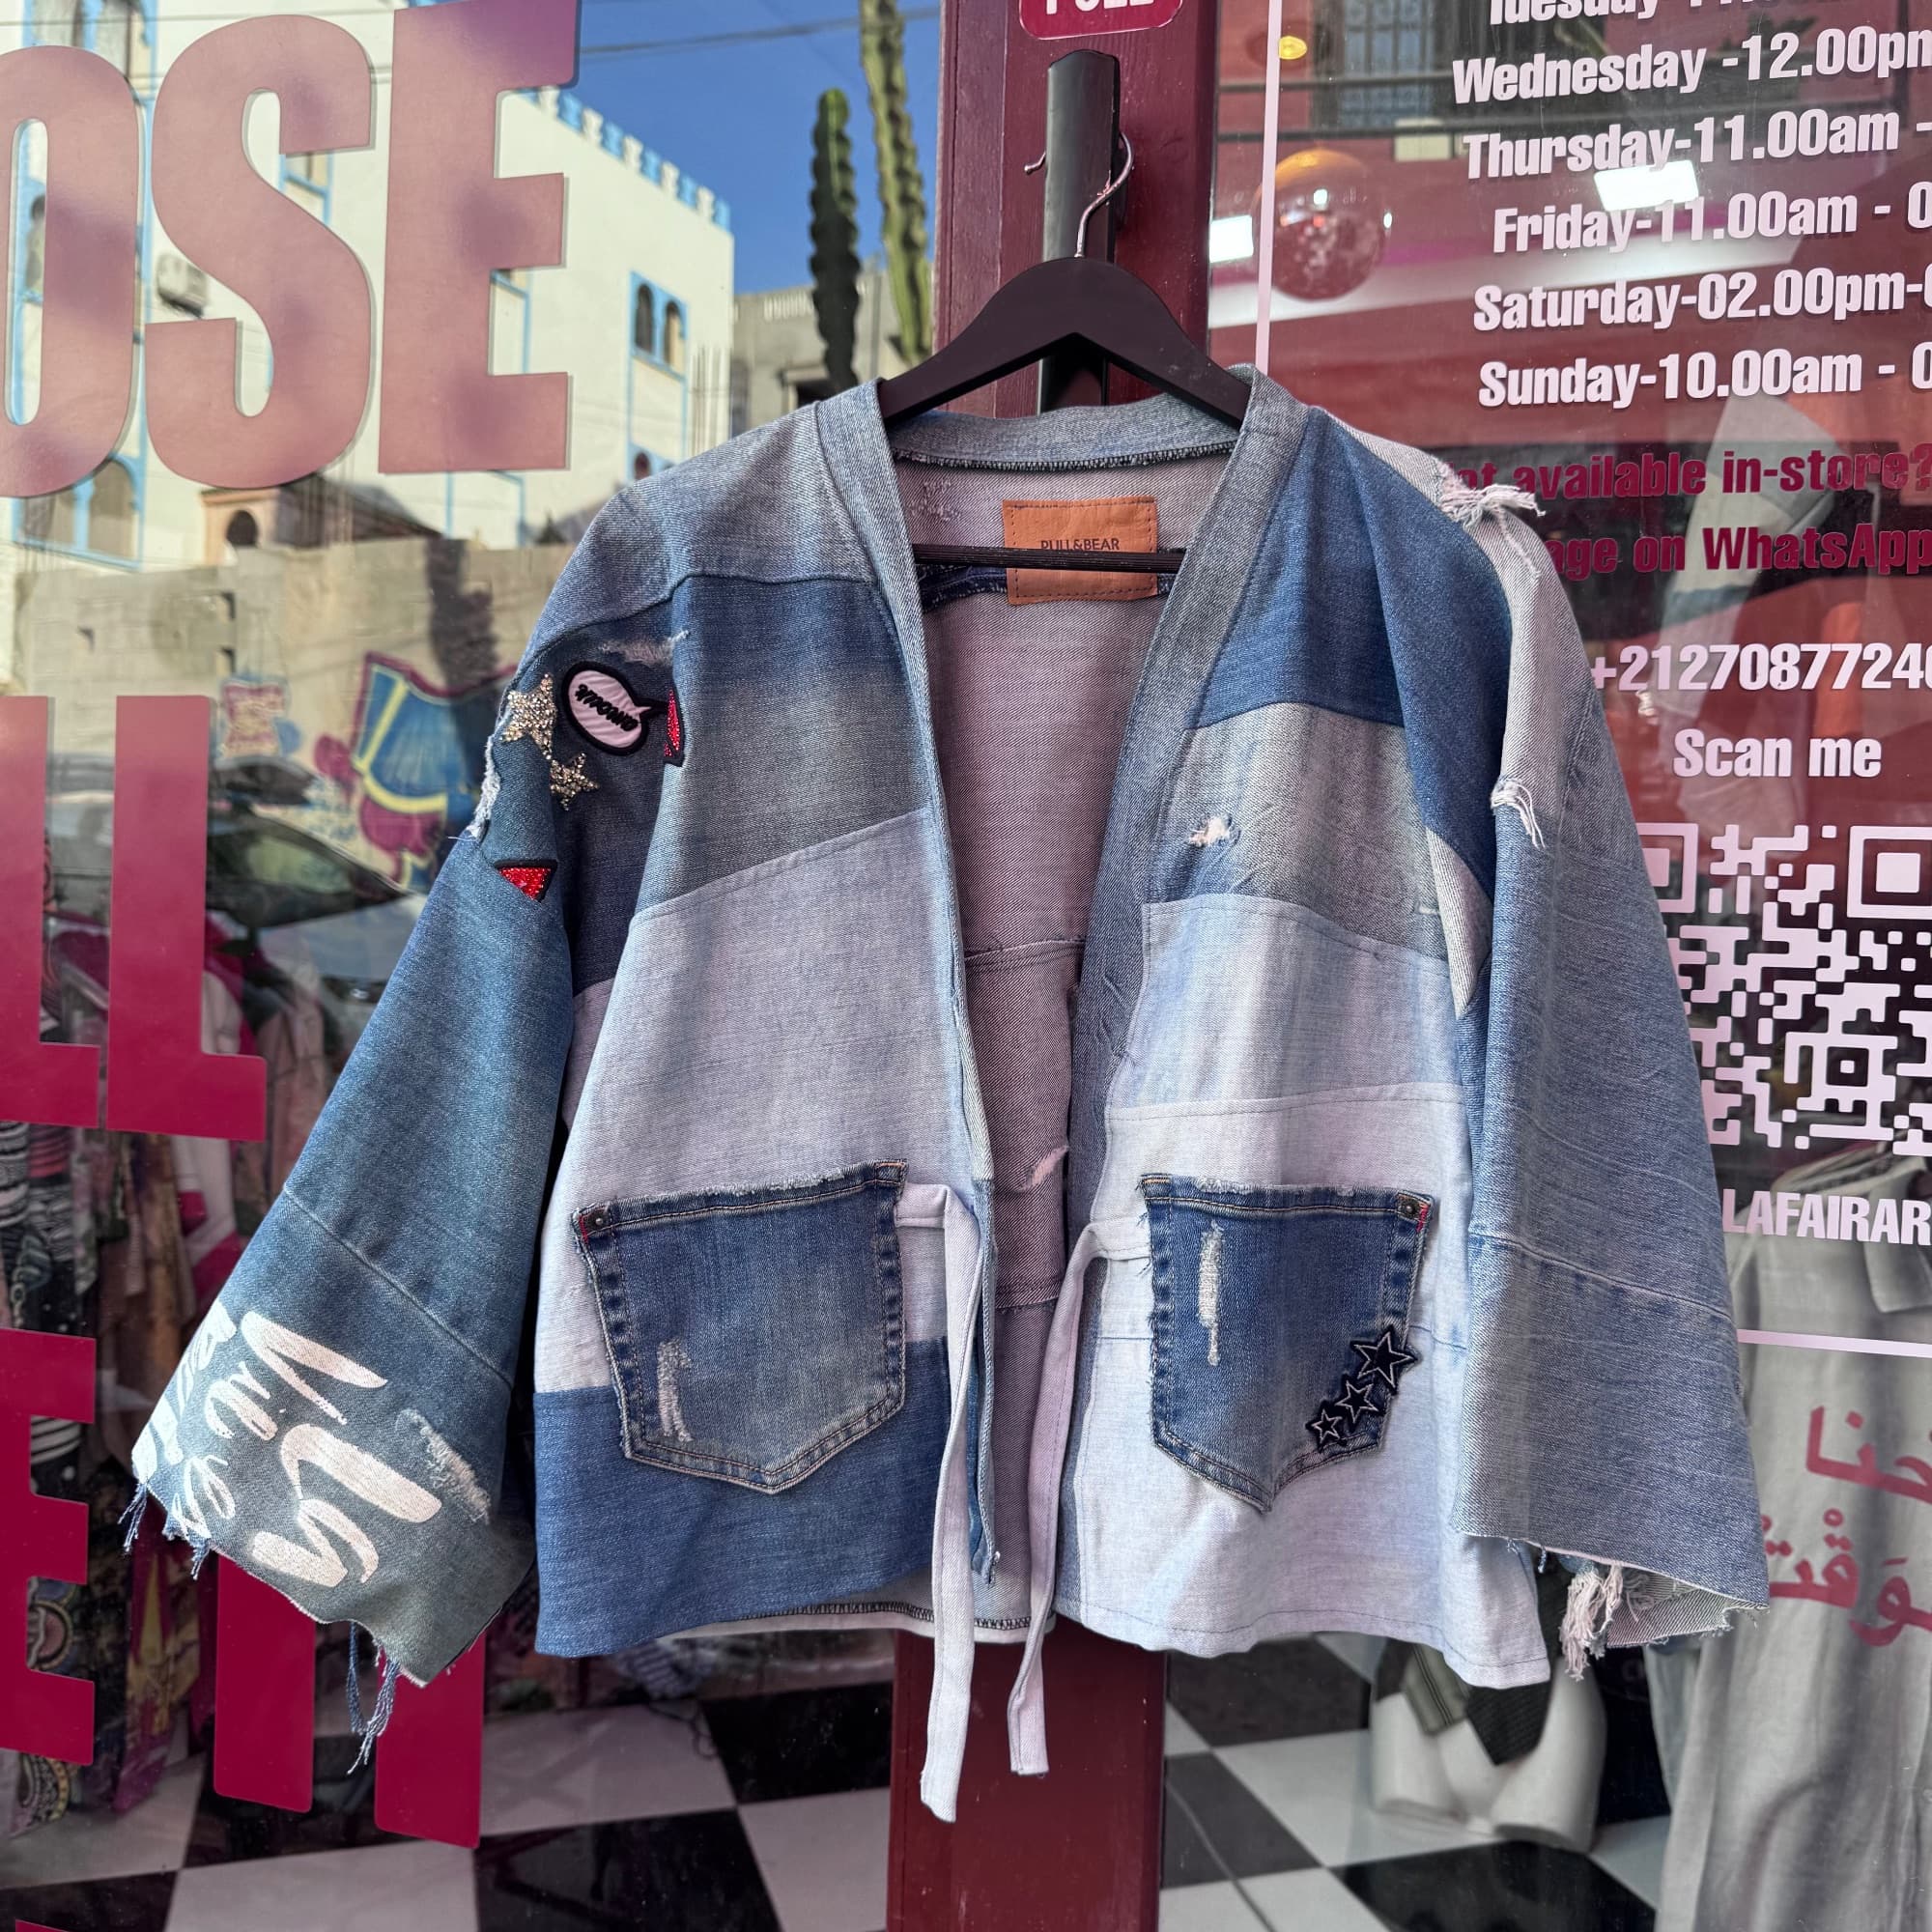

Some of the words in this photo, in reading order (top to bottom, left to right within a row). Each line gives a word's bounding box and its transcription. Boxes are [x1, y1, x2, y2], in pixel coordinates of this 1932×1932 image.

[1452, 44, 1707, 104] Wednesday
[1473, 263, 1932, 332] Saturday-02.00pm-
[1478, 348, 1862, 410] Sunday-10.00am
[1512, 451, 1707, 500] available
[1633, 535, 1687, 573] on
[1702, 523, 1932, 576] WhatsApp
[1591, 642, 1932, 692] +2127087724
[1673, 728, 1793, 778] Scan
[1807, 737, 1883, 778] me
